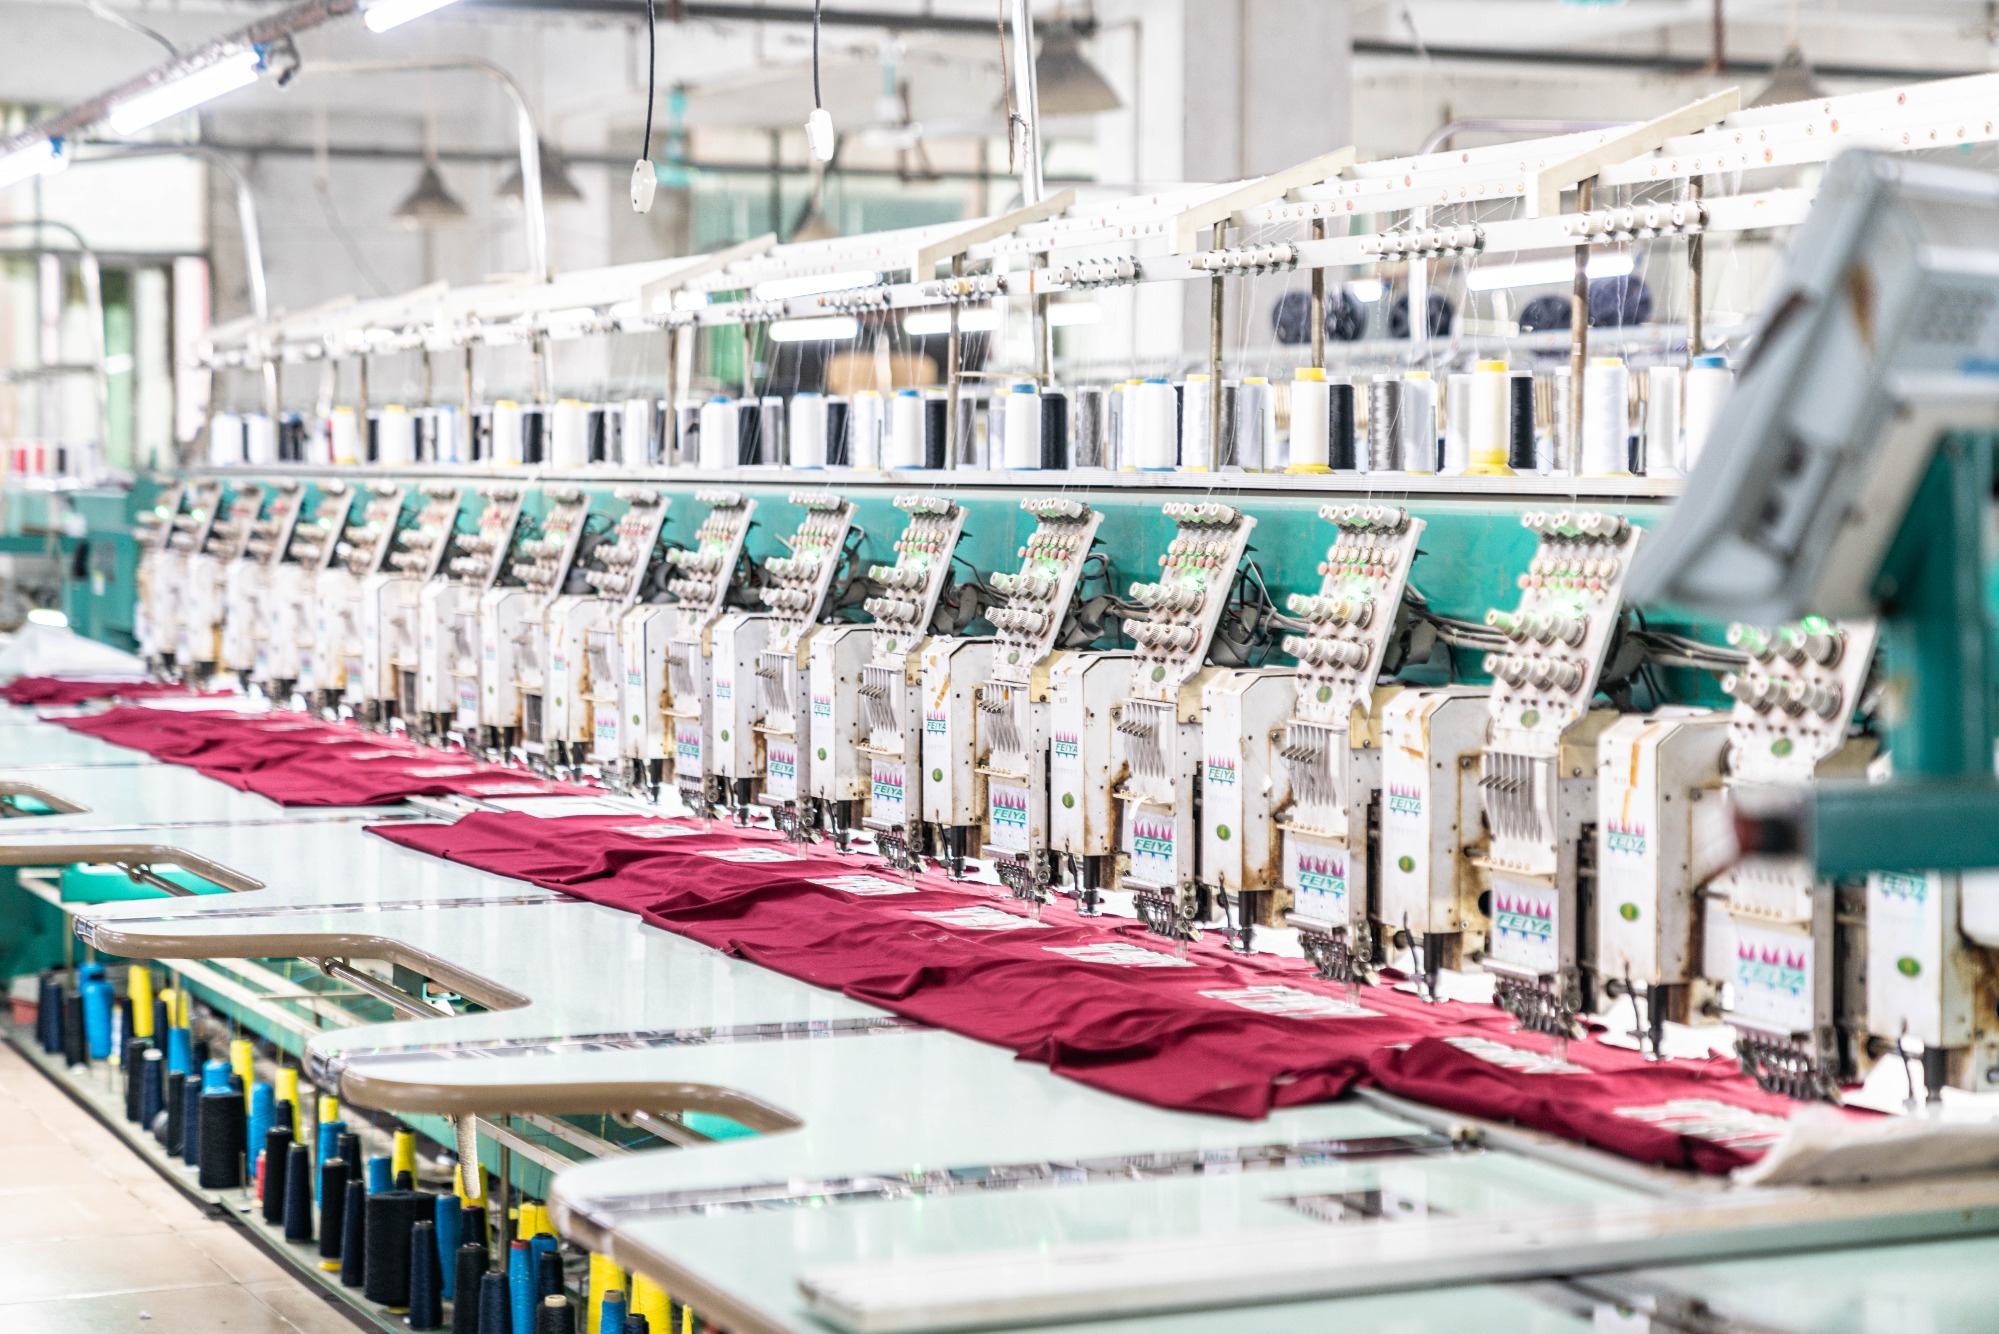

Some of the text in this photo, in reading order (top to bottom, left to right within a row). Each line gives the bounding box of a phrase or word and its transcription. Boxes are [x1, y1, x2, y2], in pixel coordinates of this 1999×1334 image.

[814, 704, 831, 713] FEIYA
[927, 721, 947, 730] FEIYA
[678, 744, 700, 757] FEIYA
[1056, 742, 1078, 753] FEIYA
[770, 762, 794, 774] FEIYA
[1209, 768, 1235, 780] FEIYA
[873, 785, 903, 797] FEIYA
[1390, 797, 1421, 811] FEIYA
[993, 808, 1026, 821] FEIYA
[1134, 838, 1173, 853] FEIYA
[1608, 834, 1646, 850] FEIYA
[1299, 873, 1345, 891] FEIYA
[1497, 913, 1552, 933] FEIYA
